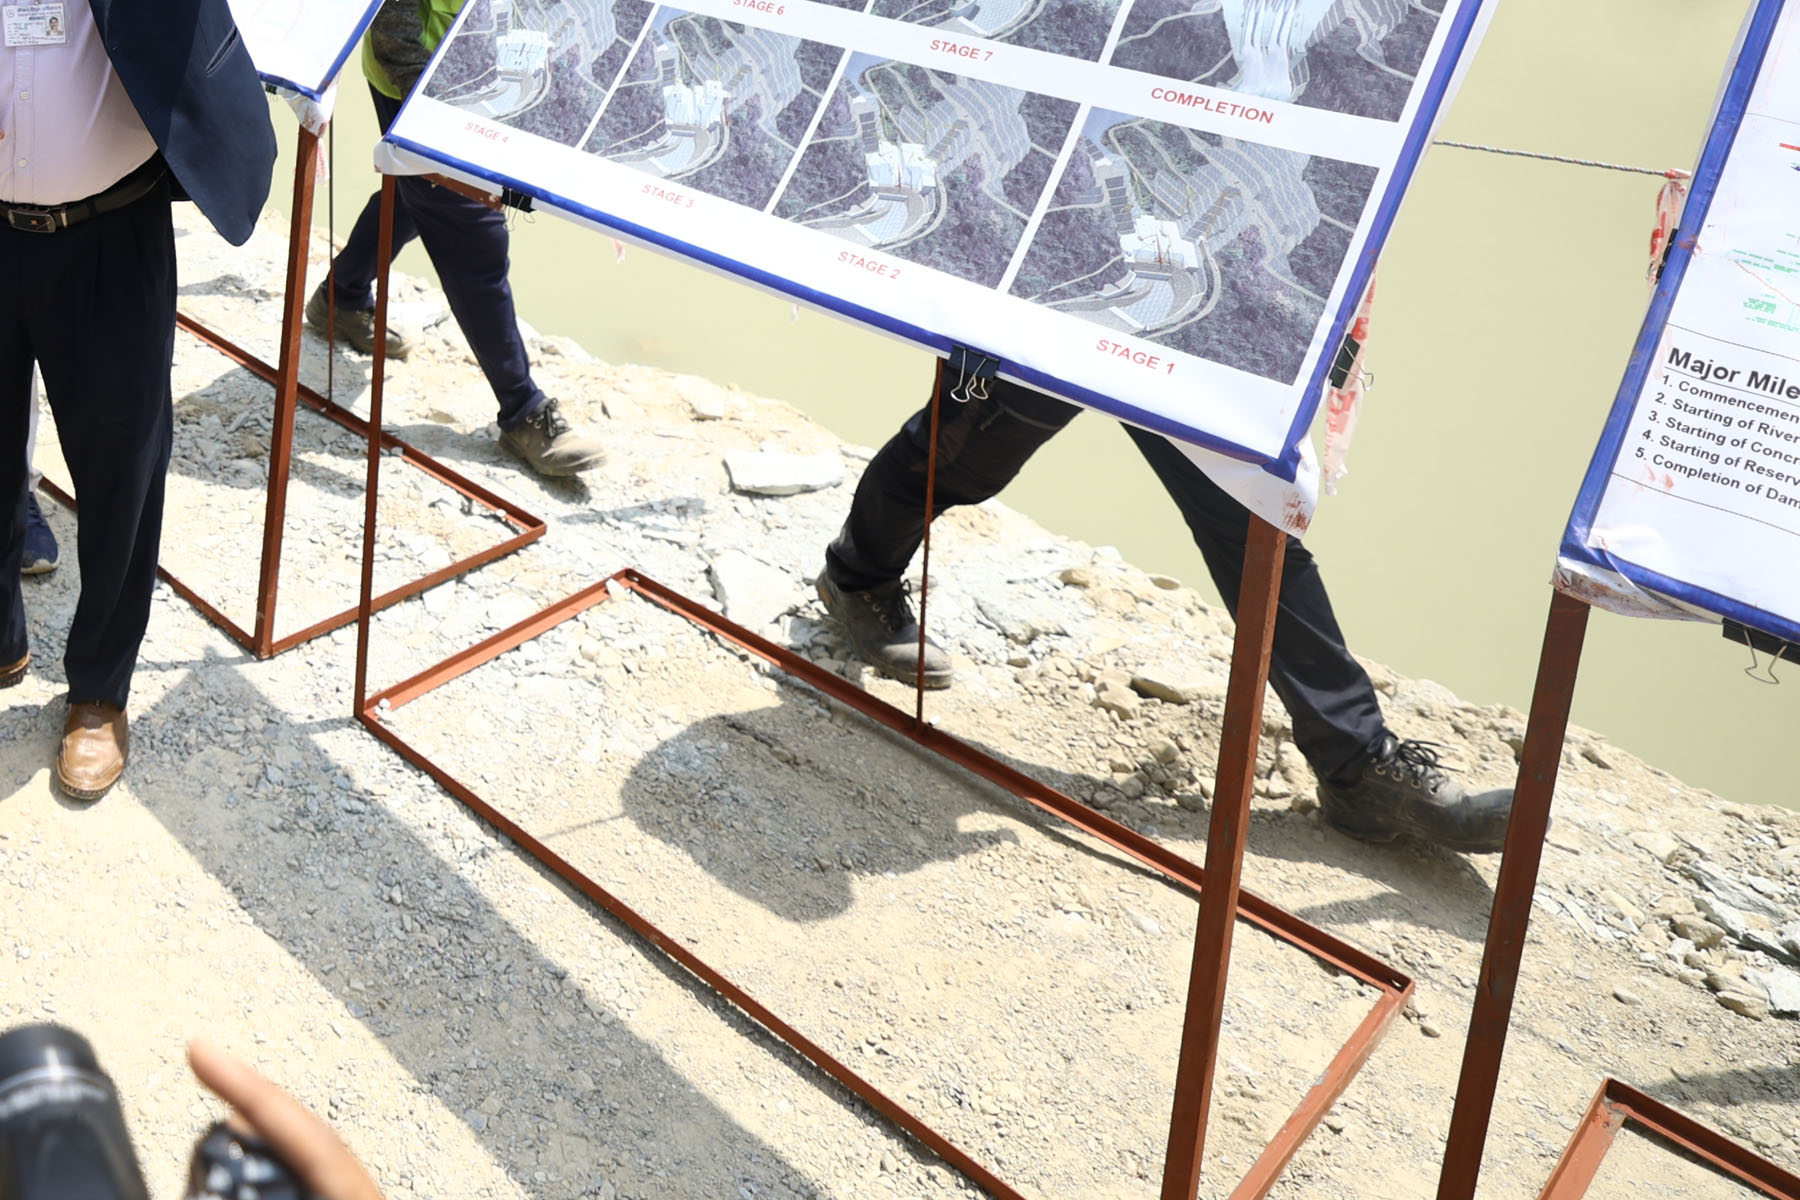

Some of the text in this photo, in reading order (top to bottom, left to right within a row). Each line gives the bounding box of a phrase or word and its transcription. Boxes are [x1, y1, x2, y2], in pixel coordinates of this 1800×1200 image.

[776, 6, 785, 15] 6
[930, 39, 993, 61] STAGE 7
[1151, 87, 1274, 124] COMPLETION
[465, 121, 510, 143] STAGE 4
[642, 184, 694, 208] STAGE 3
[837, 251, 901, 280] STAGE 2
[1096, 339, 1175, 375] STAGE 1
[1668, 347, 1800, 400] Major Mile
[1655, 392, 1800, 444] 2. Starting of River
[1662, 375, 1800, 424] 1. Commencemen
[1648, 410, 1660, 424] 3.
[1665, 417, 1727, 446] Starting
[1730, 438, 1748, 449] of
[1641, 429, 1654, 442] 4.
[1659, 435, 1720, 465] Starting
[1724, 456, 1741, 468] of
[1634, 446, 1647, 461] 5.
[1652, 453, 1740, 489] Completion
[1745, 484, 1763, 495] of
